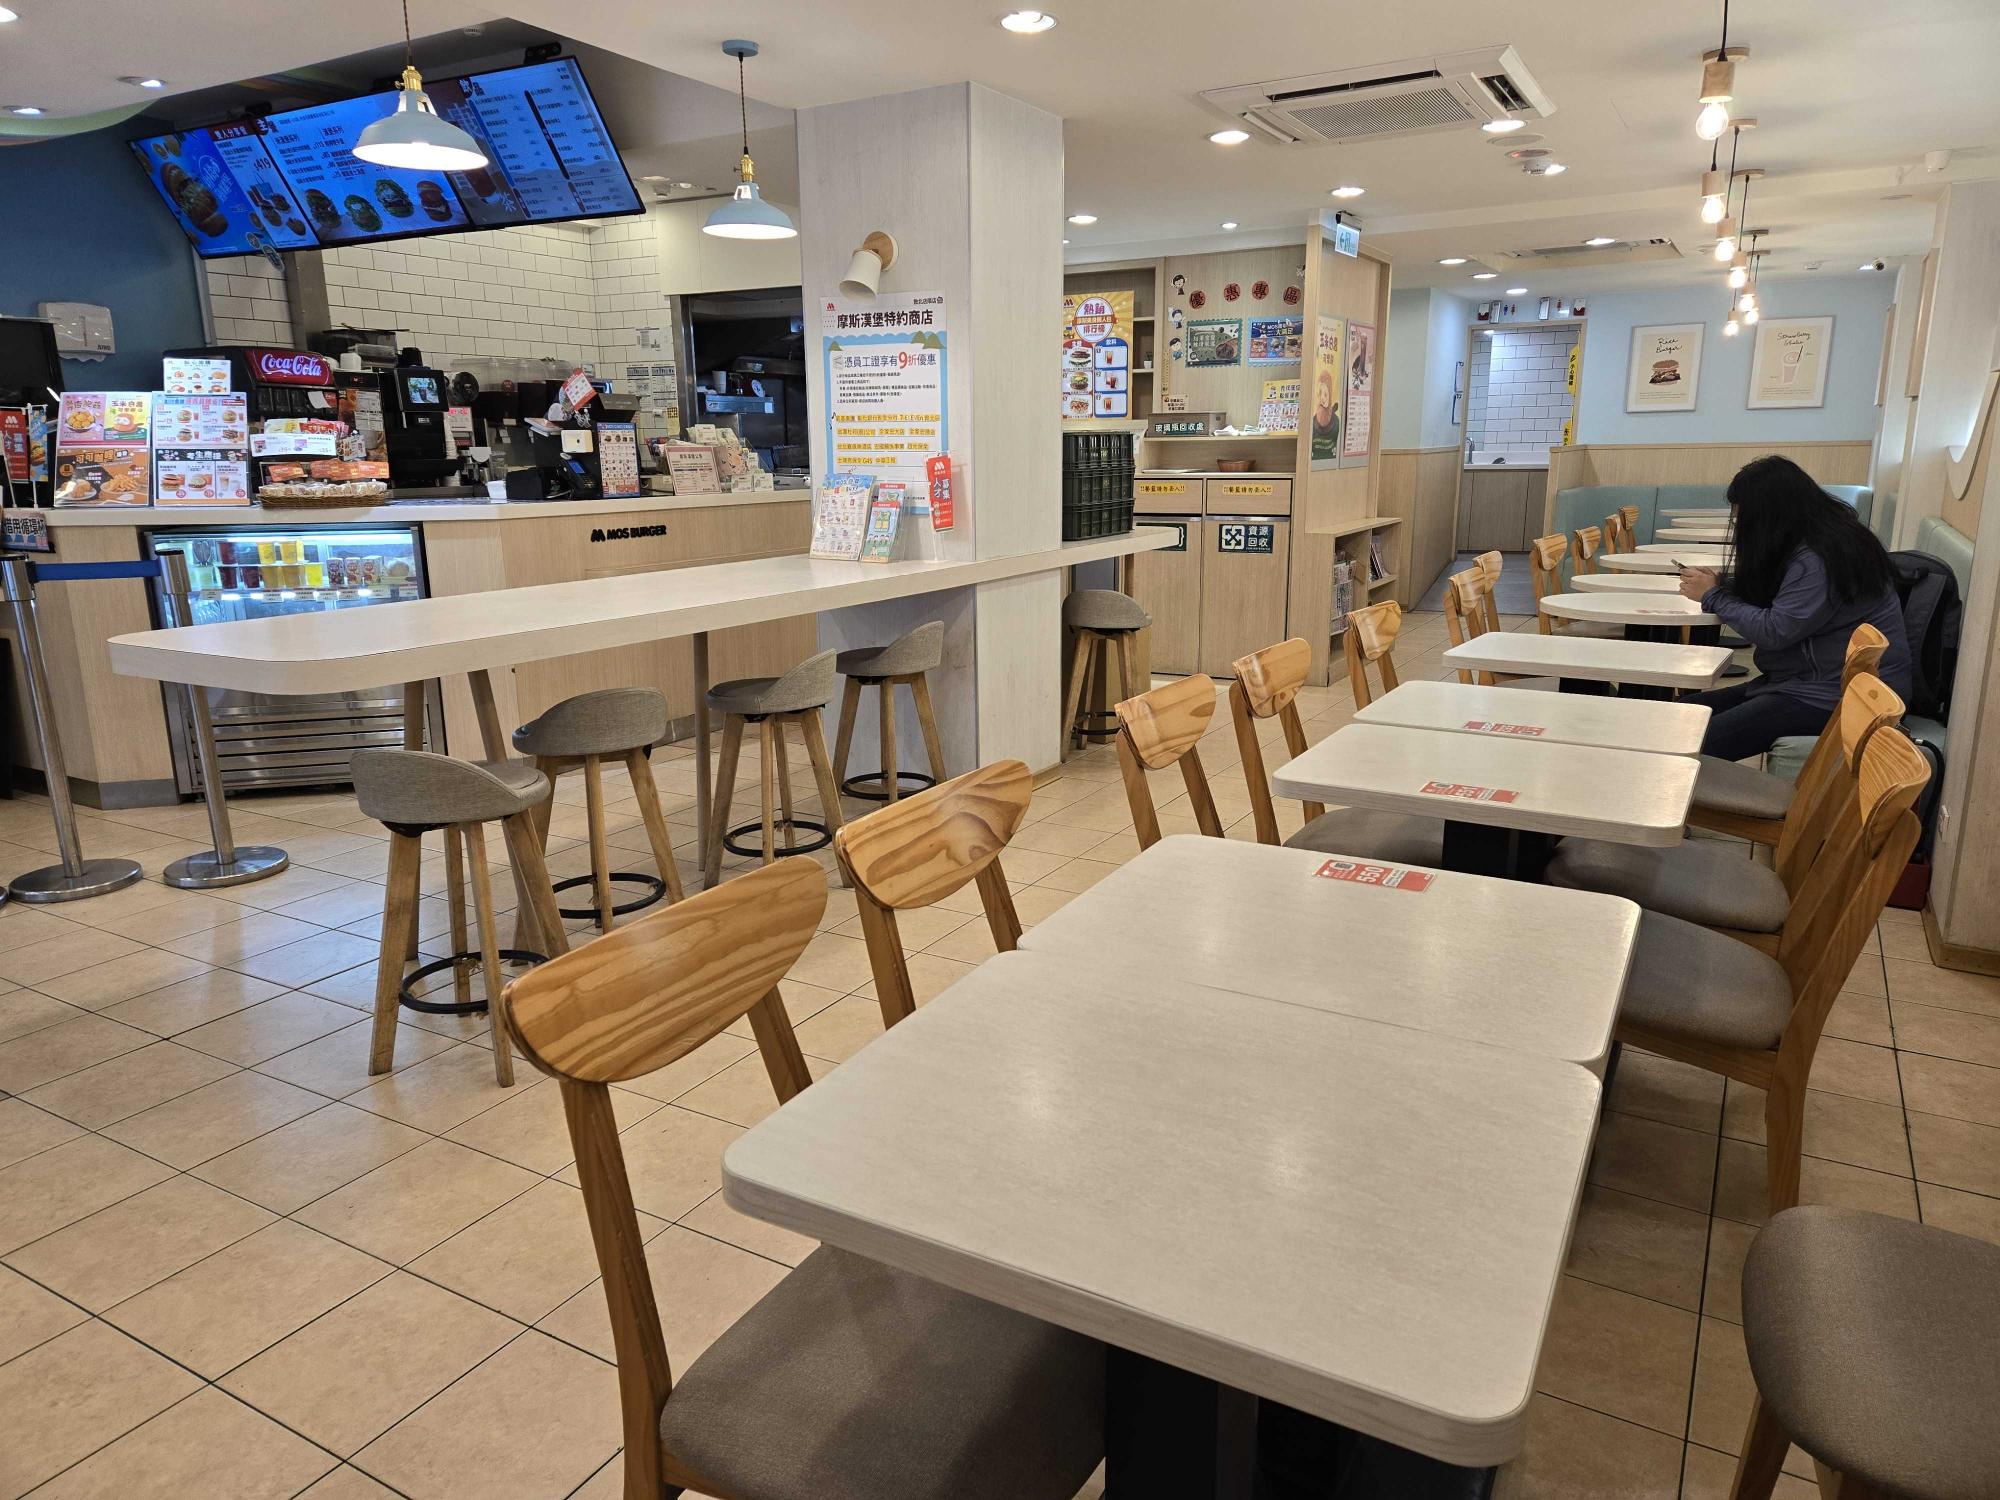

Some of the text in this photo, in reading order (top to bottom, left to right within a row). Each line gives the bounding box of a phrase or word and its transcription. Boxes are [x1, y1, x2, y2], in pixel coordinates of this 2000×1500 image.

[837, 309, 933, 329] 摩斯漢堡特約商店
[1155, 422, 1204, 433] 玻璃瓶回收處
[607, 525, 667, 540] MOS BURGER
[1248, 526, 1269, 536] 資源
[1248, 537, 1268, 547] 回收
[1356, 866, 1385, 883] 550
